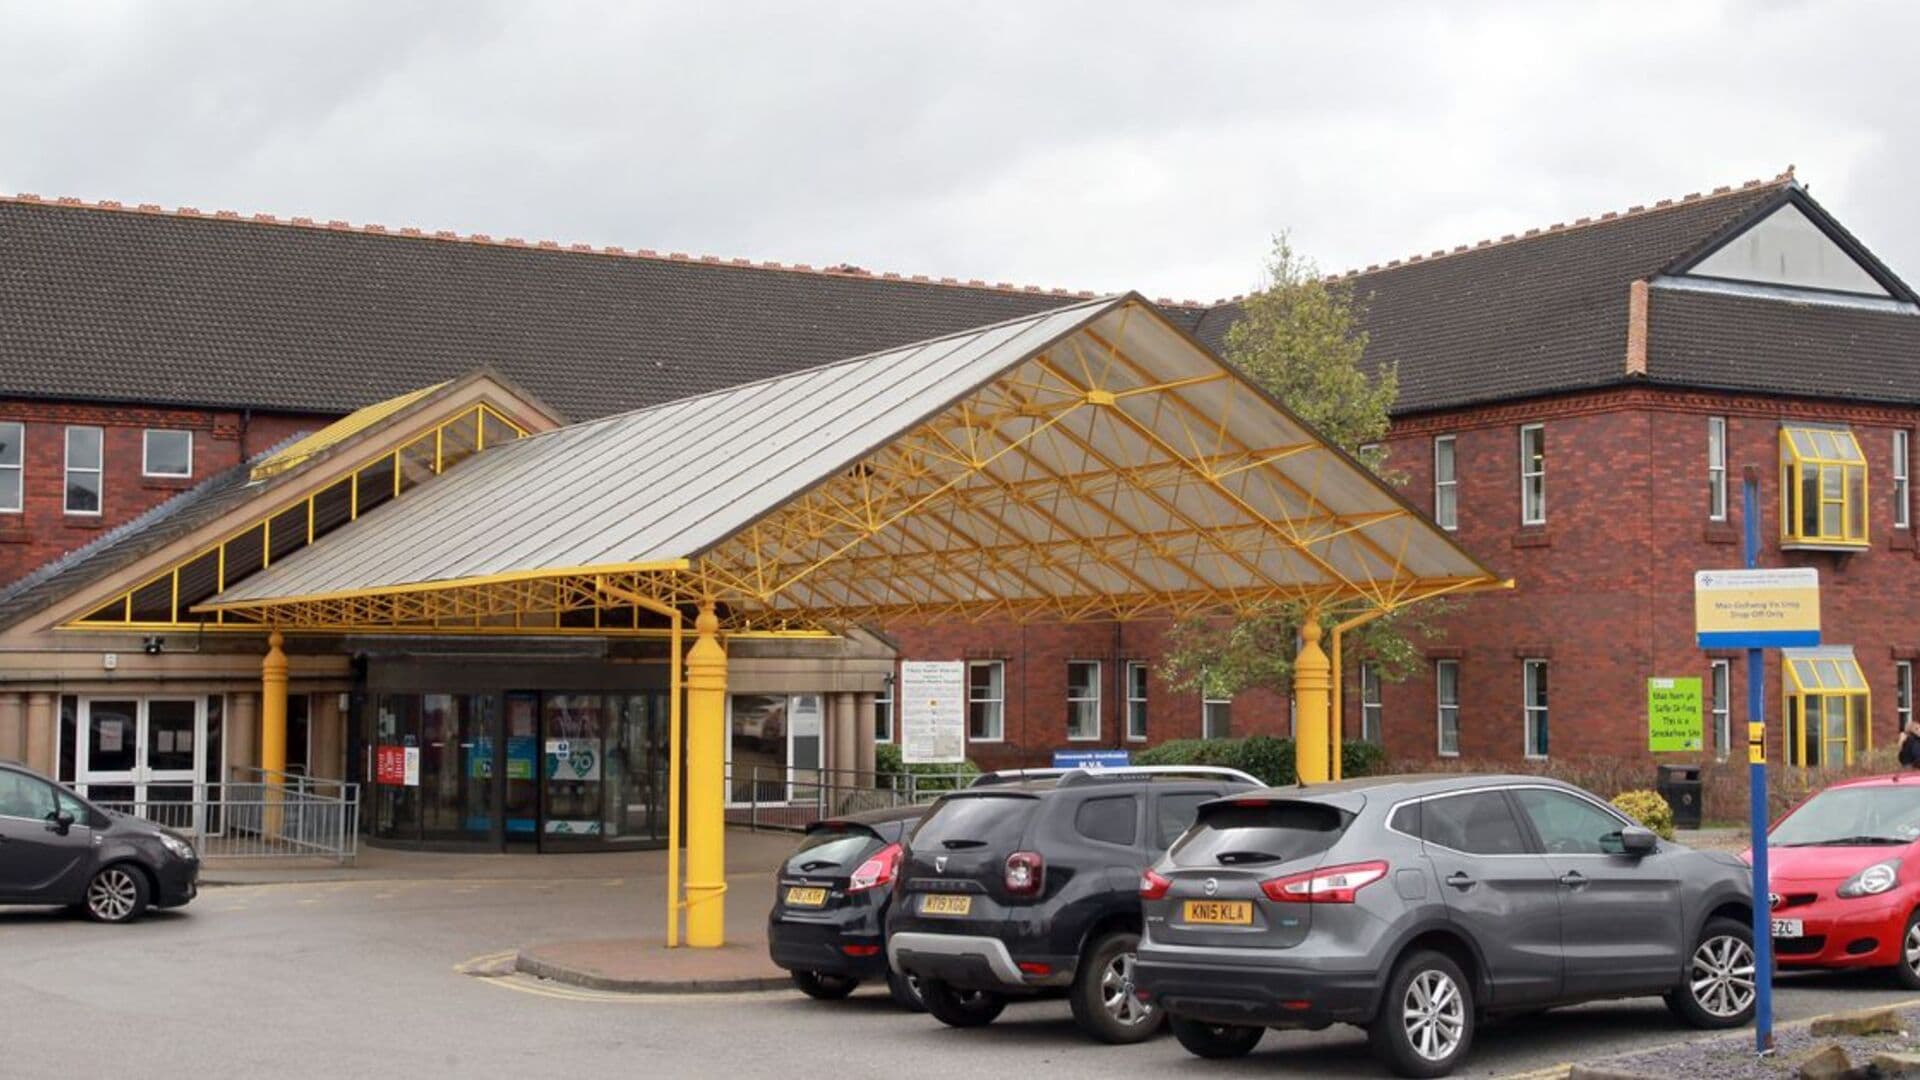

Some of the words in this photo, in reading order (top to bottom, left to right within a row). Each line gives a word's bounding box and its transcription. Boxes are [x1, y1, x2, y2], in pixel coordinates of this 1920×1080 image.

[572, 753, 592, 769] 70
[1191, 904, 1218, 920] KN15
[1220, 904, 1245, 921] KLA
